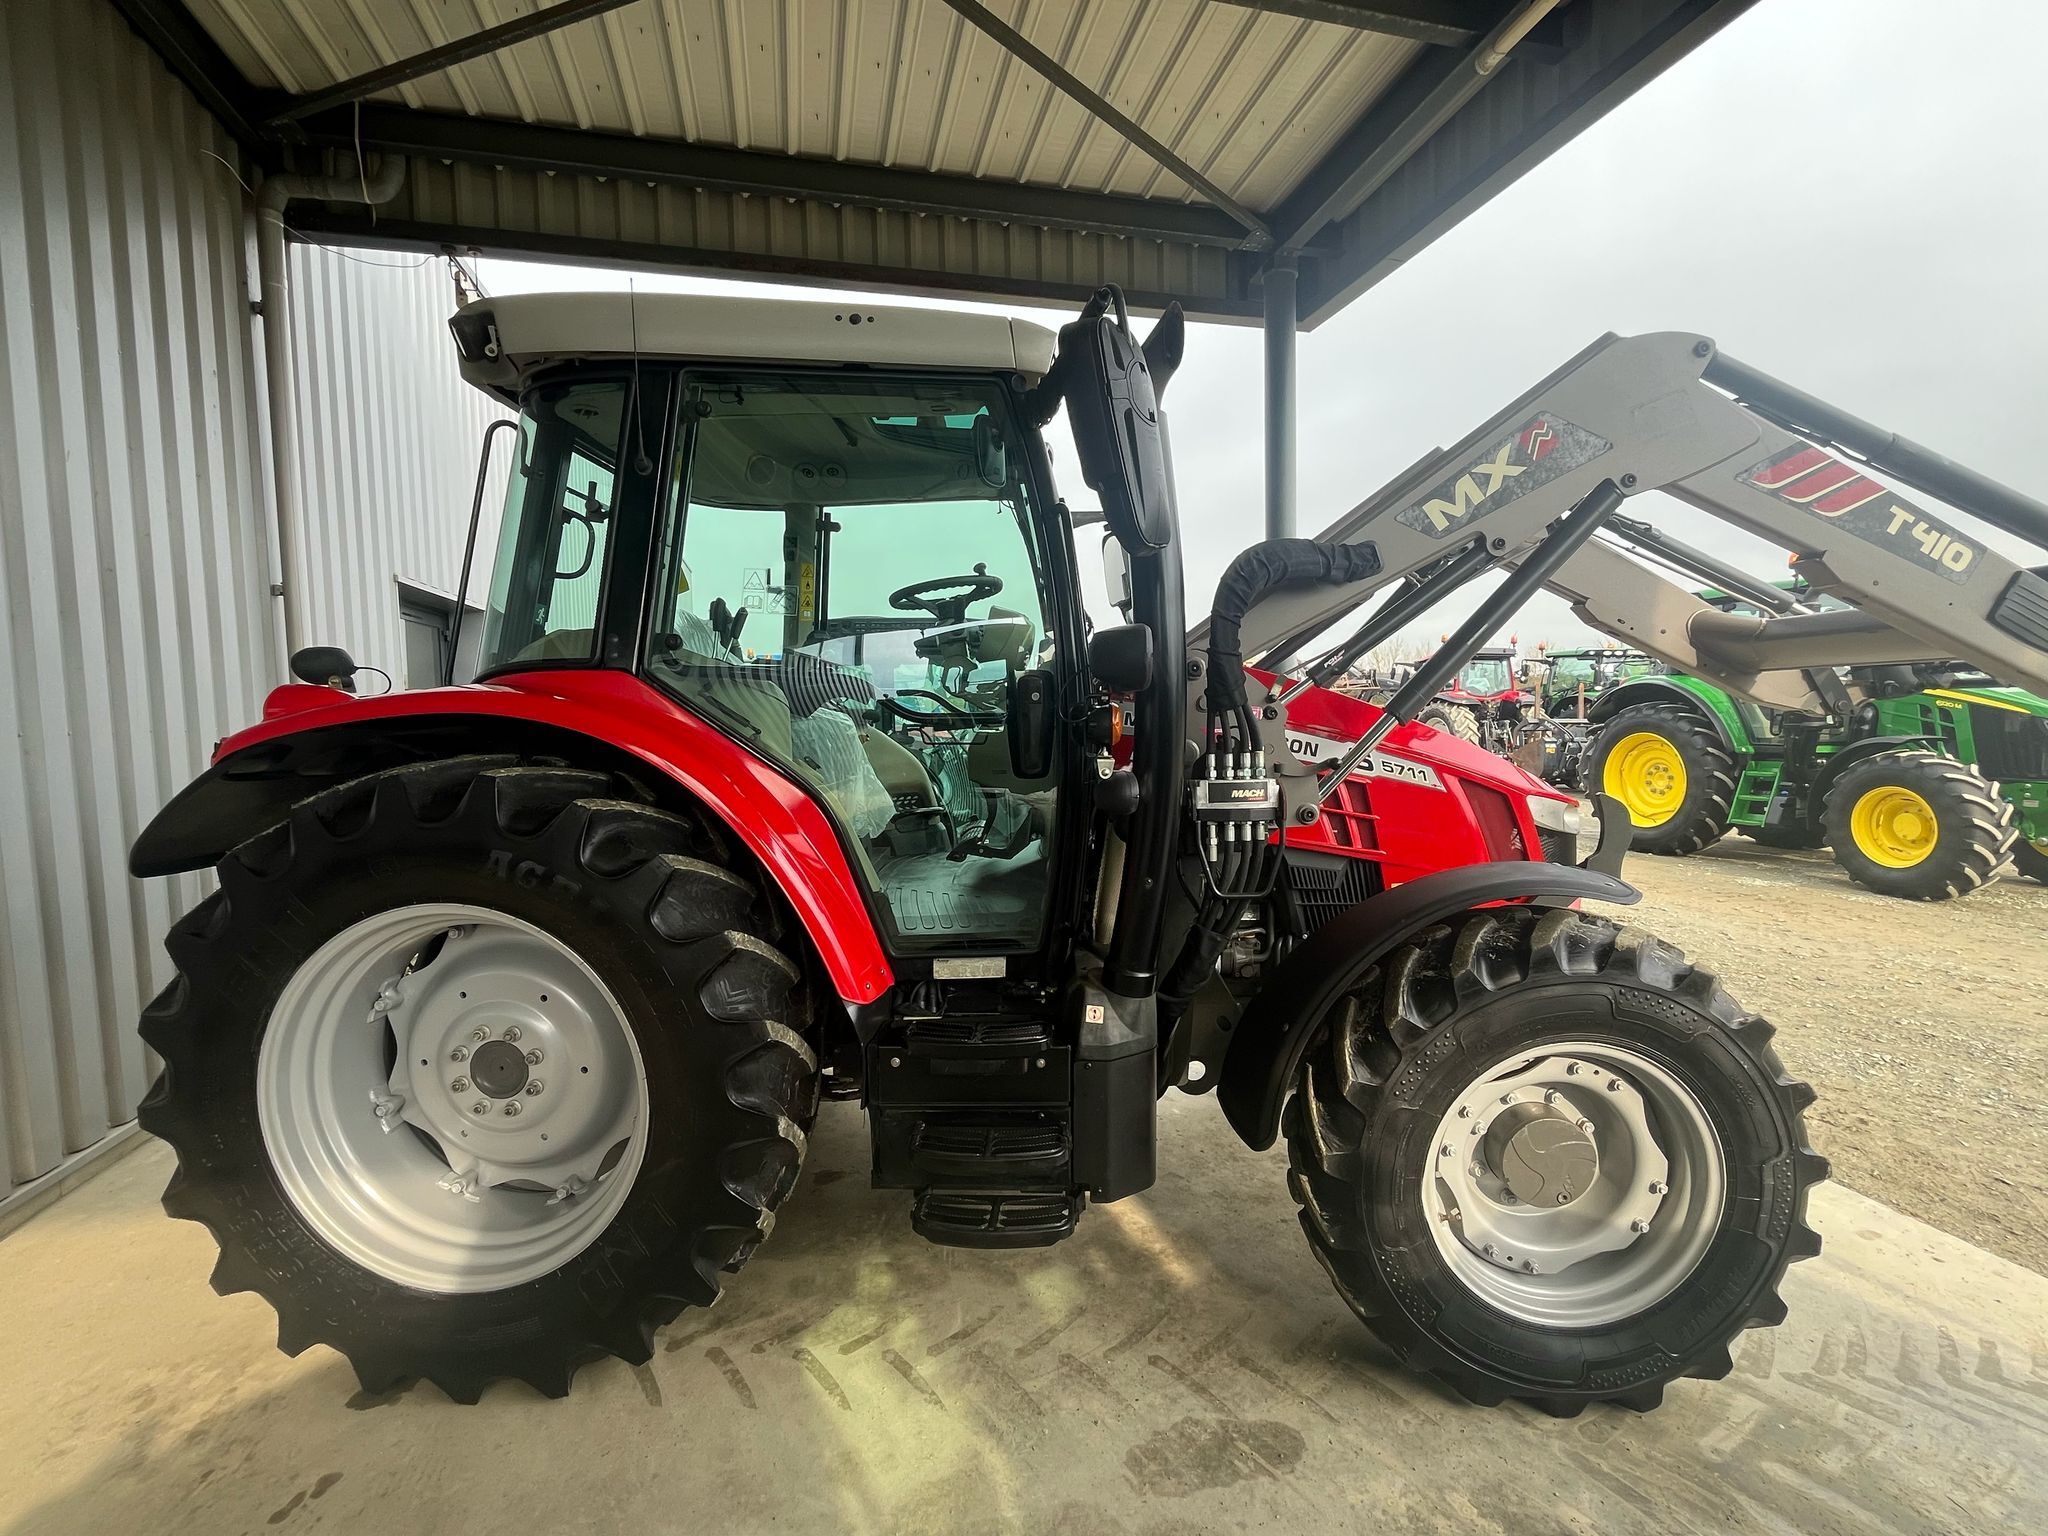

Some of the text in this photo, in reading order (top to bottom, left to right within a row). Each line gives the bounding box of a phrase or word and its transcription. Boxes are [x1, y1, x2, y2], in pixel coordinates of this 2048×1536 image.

[1422, 443, 1528, 532] MX
[1886, 504, 1974, 573] T410
[1231, 789, 1265, 798] MACH
[1381, 760, 1429, 782] 5711
